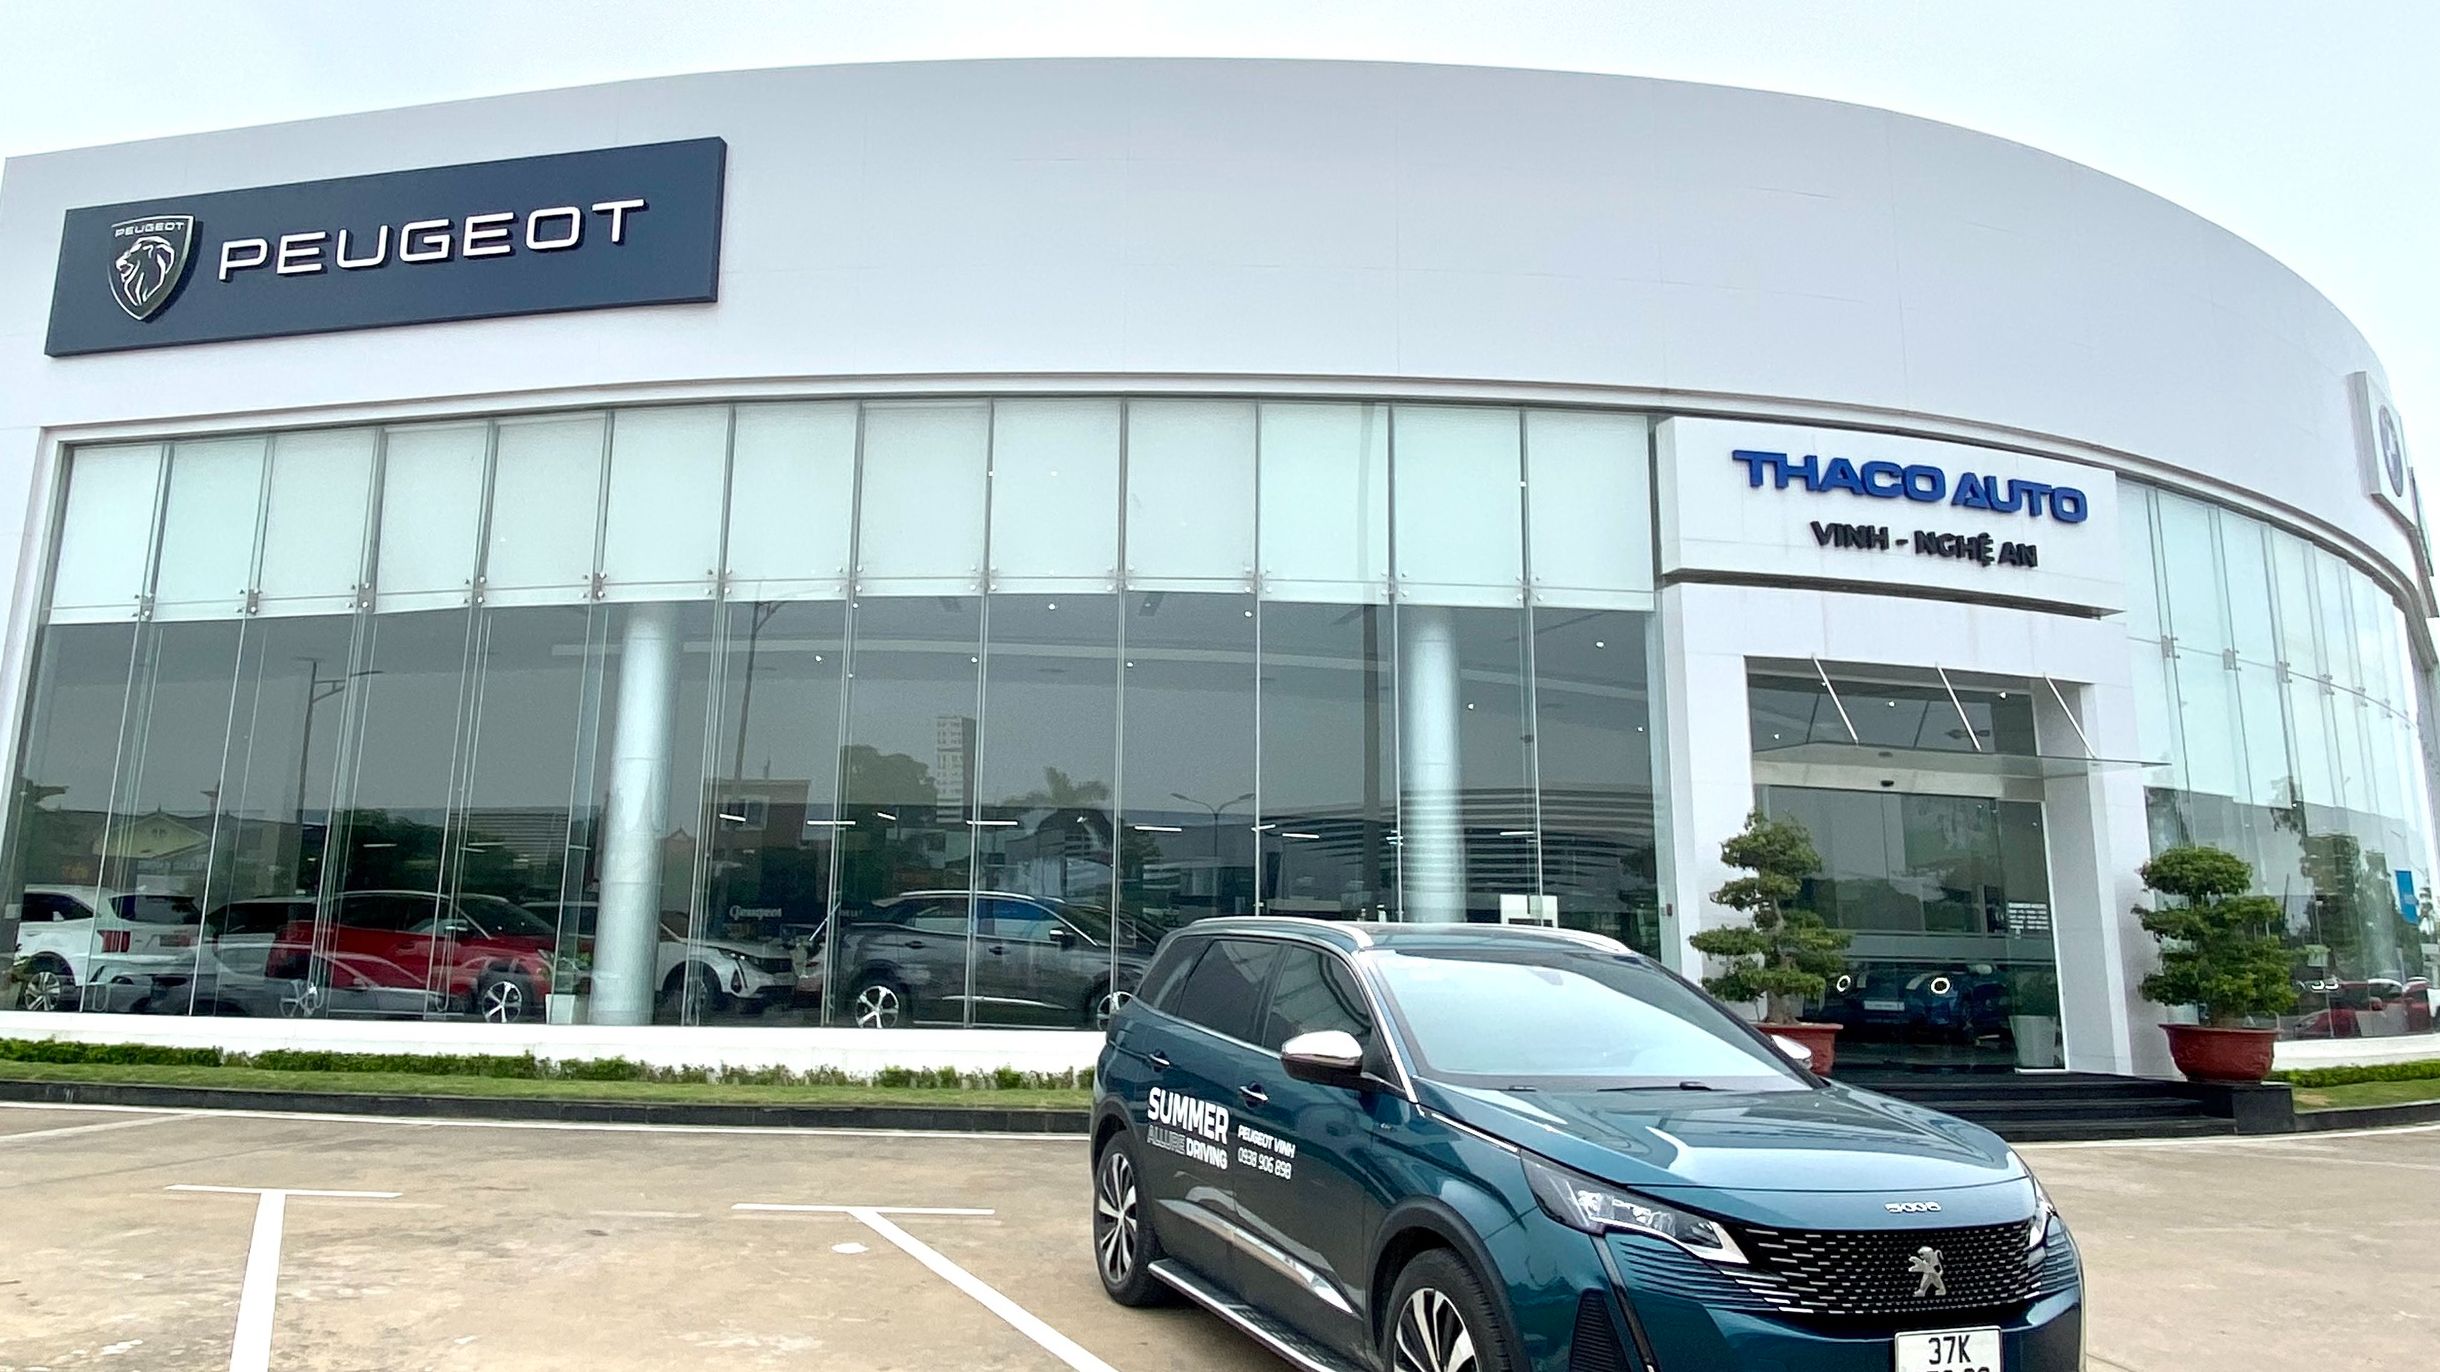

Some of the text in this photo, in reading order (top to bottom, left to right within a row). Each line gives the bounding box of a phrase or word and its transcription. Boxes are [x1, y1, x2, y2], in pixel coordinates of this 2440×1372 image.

[114, 221, 185, 238] PEUGEOT
[218, 198, 645, 281] PEUGEOT
[1732, 450, 2088, 524] THACO AUTO
[1810, 521, 1889, 550] VINH
[1914, 530, 1995, 567] NGHỆ
[1997, 541, 2038, 567] AN
[1147, 1086, 1230, 1145] SUMMER
[1147, 1124, 1228, 1170] ALLURE DRIVING
[1237, 1124, 1296, 1158] PEUGEOT VINH
[1258, 1153, 1275, 1174] 906
[1928, 1334, 1972, 1365] 37K
